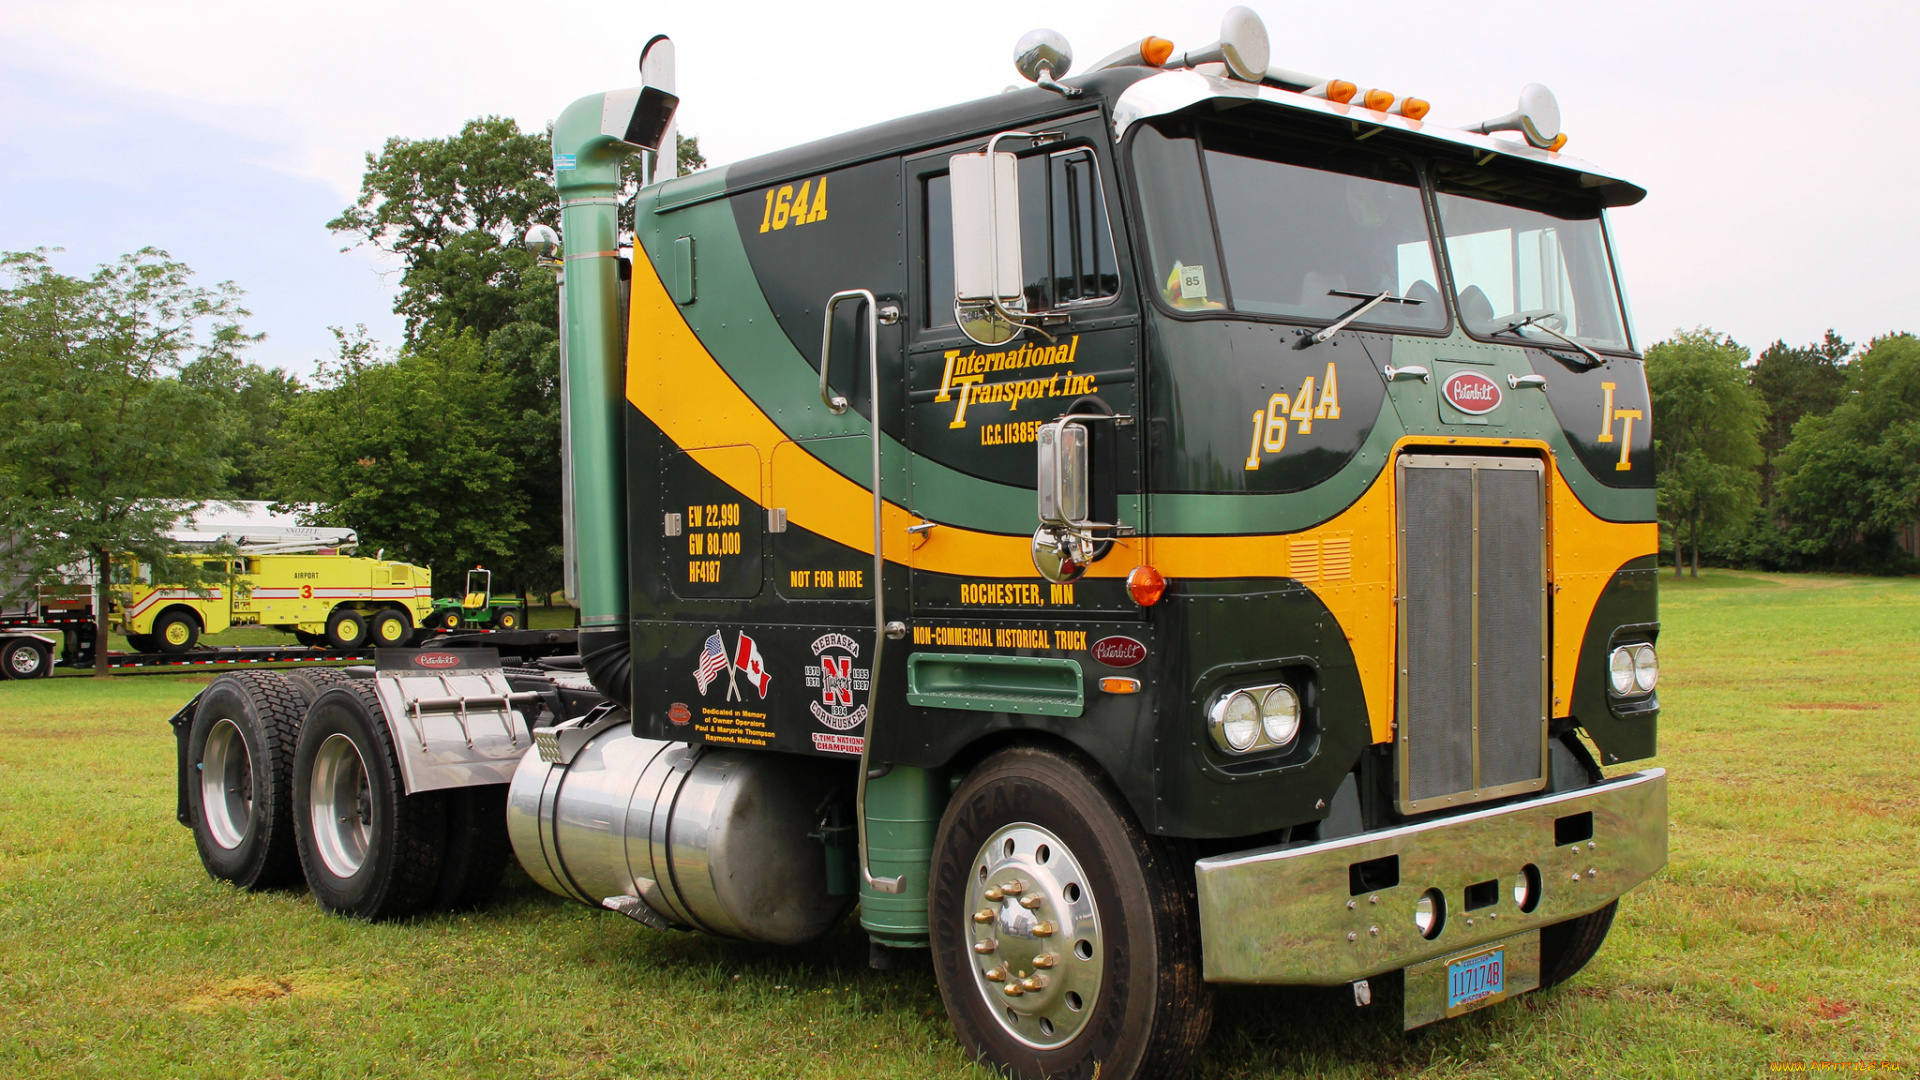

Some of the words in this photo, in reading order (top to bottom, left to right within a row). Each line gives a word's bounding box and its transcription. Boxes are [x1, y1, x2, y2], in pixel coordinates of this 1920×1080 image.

[759, 176, 828, 233] 164A
[1186, 276, 1200, 287] 85
[934, 335, 1080, 403] International
[1454, 380, 1494, 401] Peterbilt
[1245, 362, 1341, 471] 164A
[688, 505, 703, 528] EW
[706, 503, 740, 529] 22,990
[689, 533, 704, 556] GW
[707, 532, 741, 558] 80,000
[689, 560, 721, 583] HF4187
[790, 570, 811, 588] NOT
[814, 570, 834, 588] FOR
[838, 570, 863, 588] HIRE
[301, 584, 312, 599] 3
[960, 583, 1045, 608] ROCHESTER,
[1050, 583, 1074, 605] MN
[811, 633, 859, 657] NEBRASKA
[913, 626, 993, 647] NON-COMMERCIAL
[996, 628, 1050, 649] HISTORICAL
[1055, 630, 1088, 651] TRUCK
[1097, 642, 1140, 659] Peterbilt
[420, 655, 456, 665] Peterbilt
[805, 666, 820, 676] 1970
[853, 668, 870, 679] 1995
[853, 680, 870, 690] 1997
[702, 707, 733, 716] Dedicated
[742, 710, 767, 720] Memory
[810, 700, 867, 730] CORNHUSKERS
[831, 706, 847, 716] 1994
[694, 724, 708, 732] Paul
[717, 726, 743, 735] Marjorie
[745, 728, 776, 738] Thompson
[712, 717, 733, 725] Owner
[735, 718, 765, 728] Operators
[705, 733, 736, 743] Raymond,
[737, 736, 766, 746] Nebraska
[1453, 961, 1500, 998] 117174B
